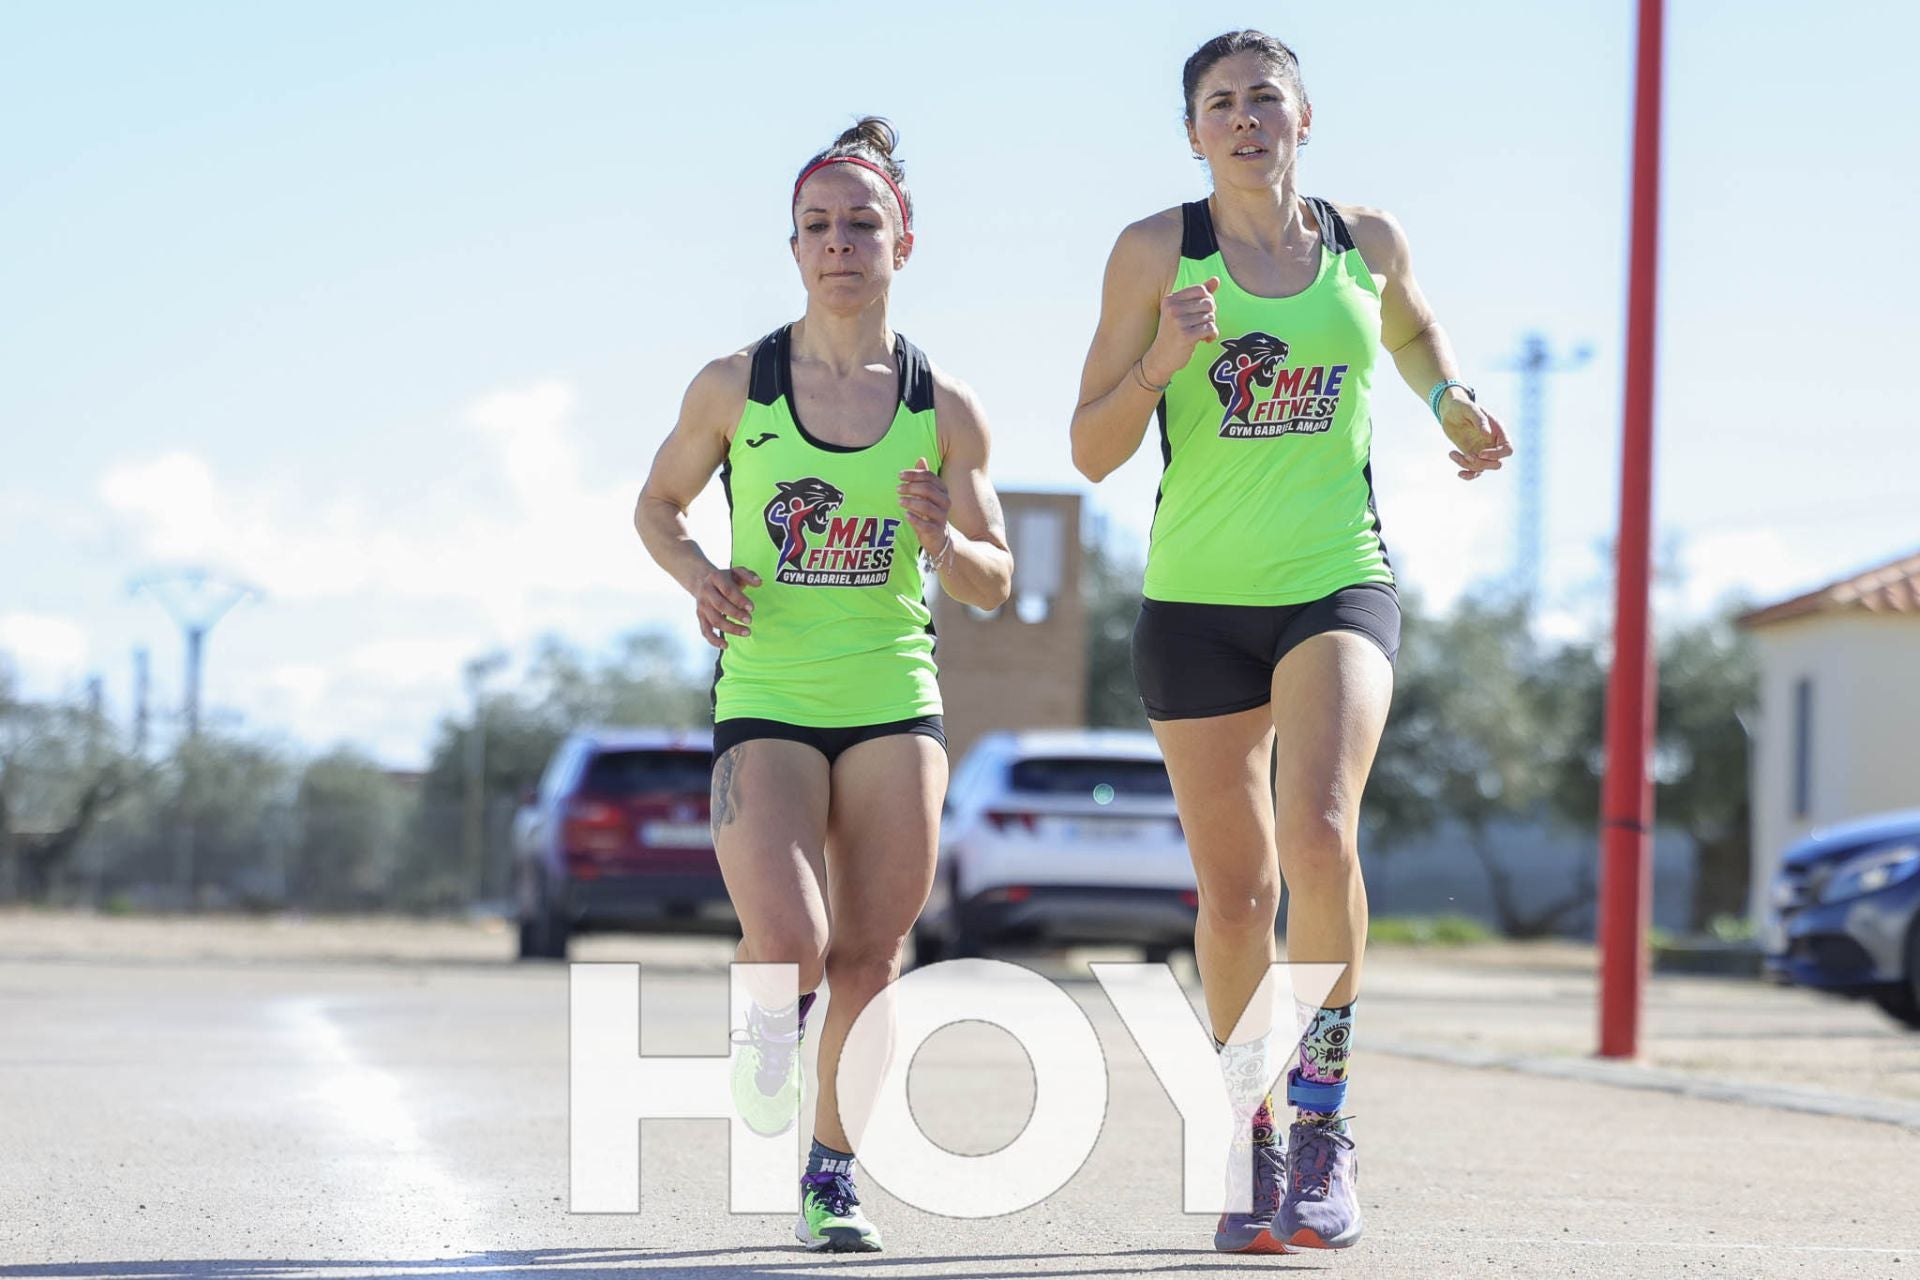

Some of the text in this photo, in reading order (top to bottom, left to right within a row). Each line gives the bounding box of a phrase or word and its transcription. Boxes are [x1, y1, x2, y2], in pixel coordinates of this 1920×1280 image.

[1271, 364, 1349, 399] MAE
[1253, 397, 1340, 422] FITNESS
[1229, 425, 1253, 436] GYM
[824, 517, 901, 548] MAE
[806, 548, 894, 570] FITNESS
[783, 572, 887, 584] GYM GABRIEL AMADO
